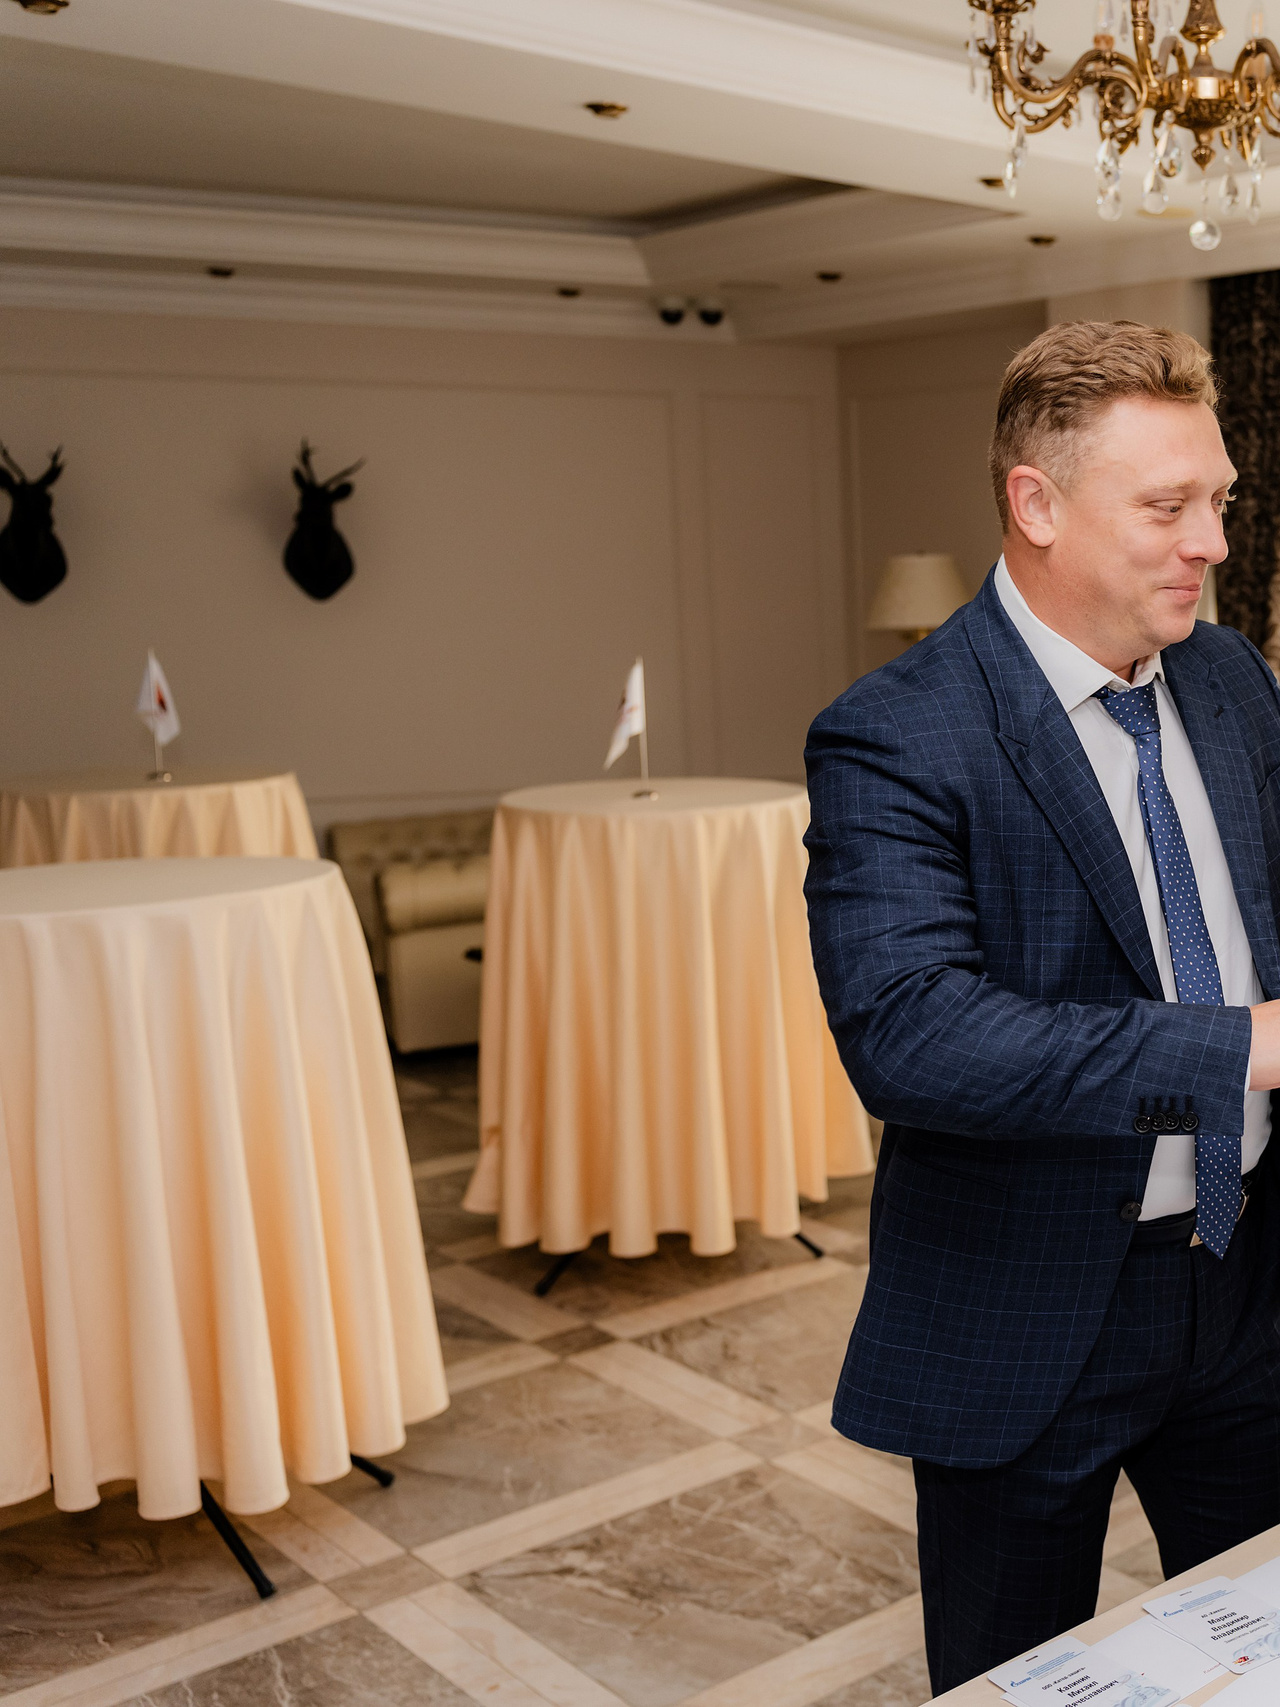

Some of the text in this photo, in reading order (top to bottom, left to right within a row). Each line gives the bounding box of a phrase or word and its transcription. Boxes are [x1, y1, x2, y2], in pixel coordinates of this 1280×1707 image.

[1207, 1611, 1237, 1626] Марков
[1211, 1614, 1249, 1632] Владимир
[1210, 1615, 1266, 1641] Владимирович
[1057, 1674, 1091, 1694] Калинин
[1067, 1680, 1099, 1698] Михаил
